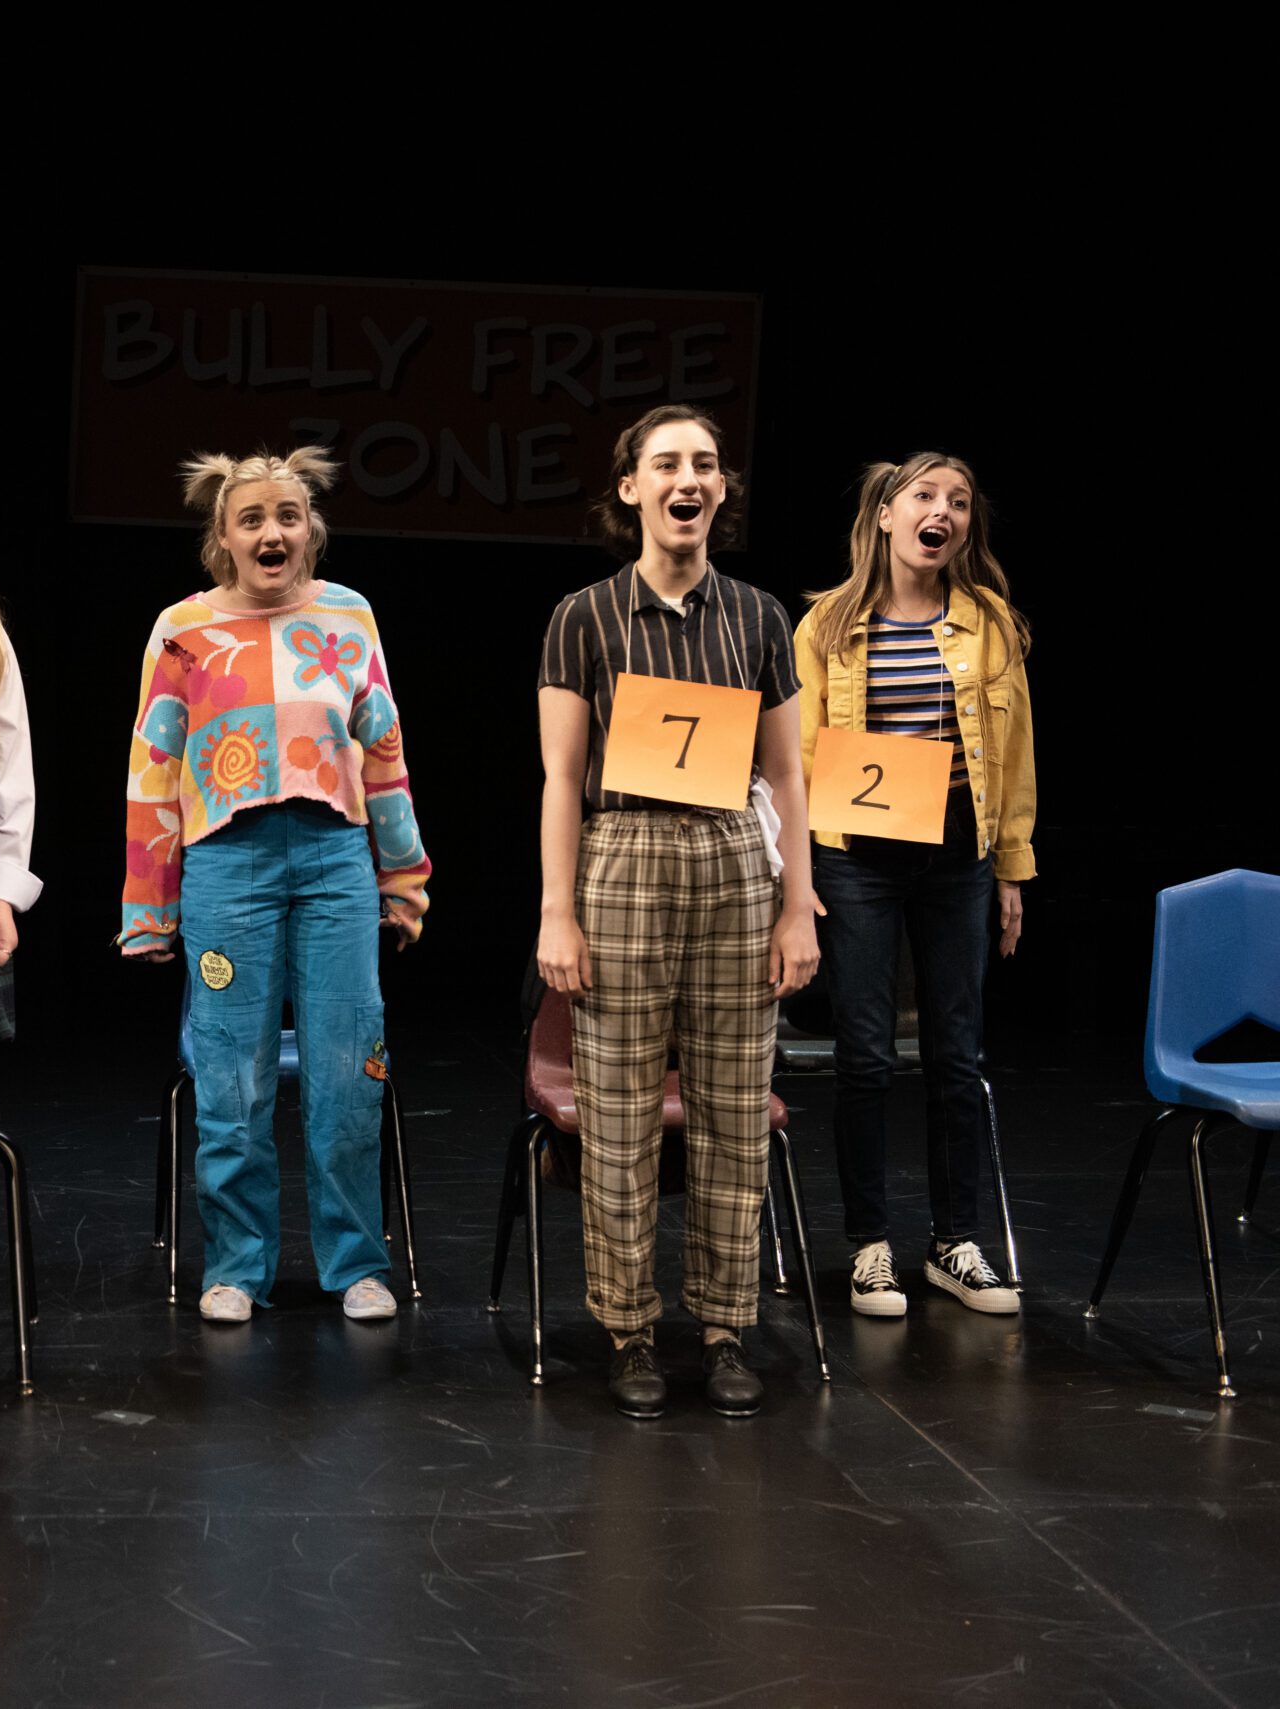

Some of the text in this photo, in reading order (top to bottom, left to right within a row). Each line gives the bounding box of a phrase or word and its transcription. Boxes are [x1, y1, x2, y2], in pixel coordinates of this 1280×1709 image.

[102, 299, 739, 414] BULLY FREE
[662, 713, 701, 769] 7
[850, 763, 891, 811] 2
